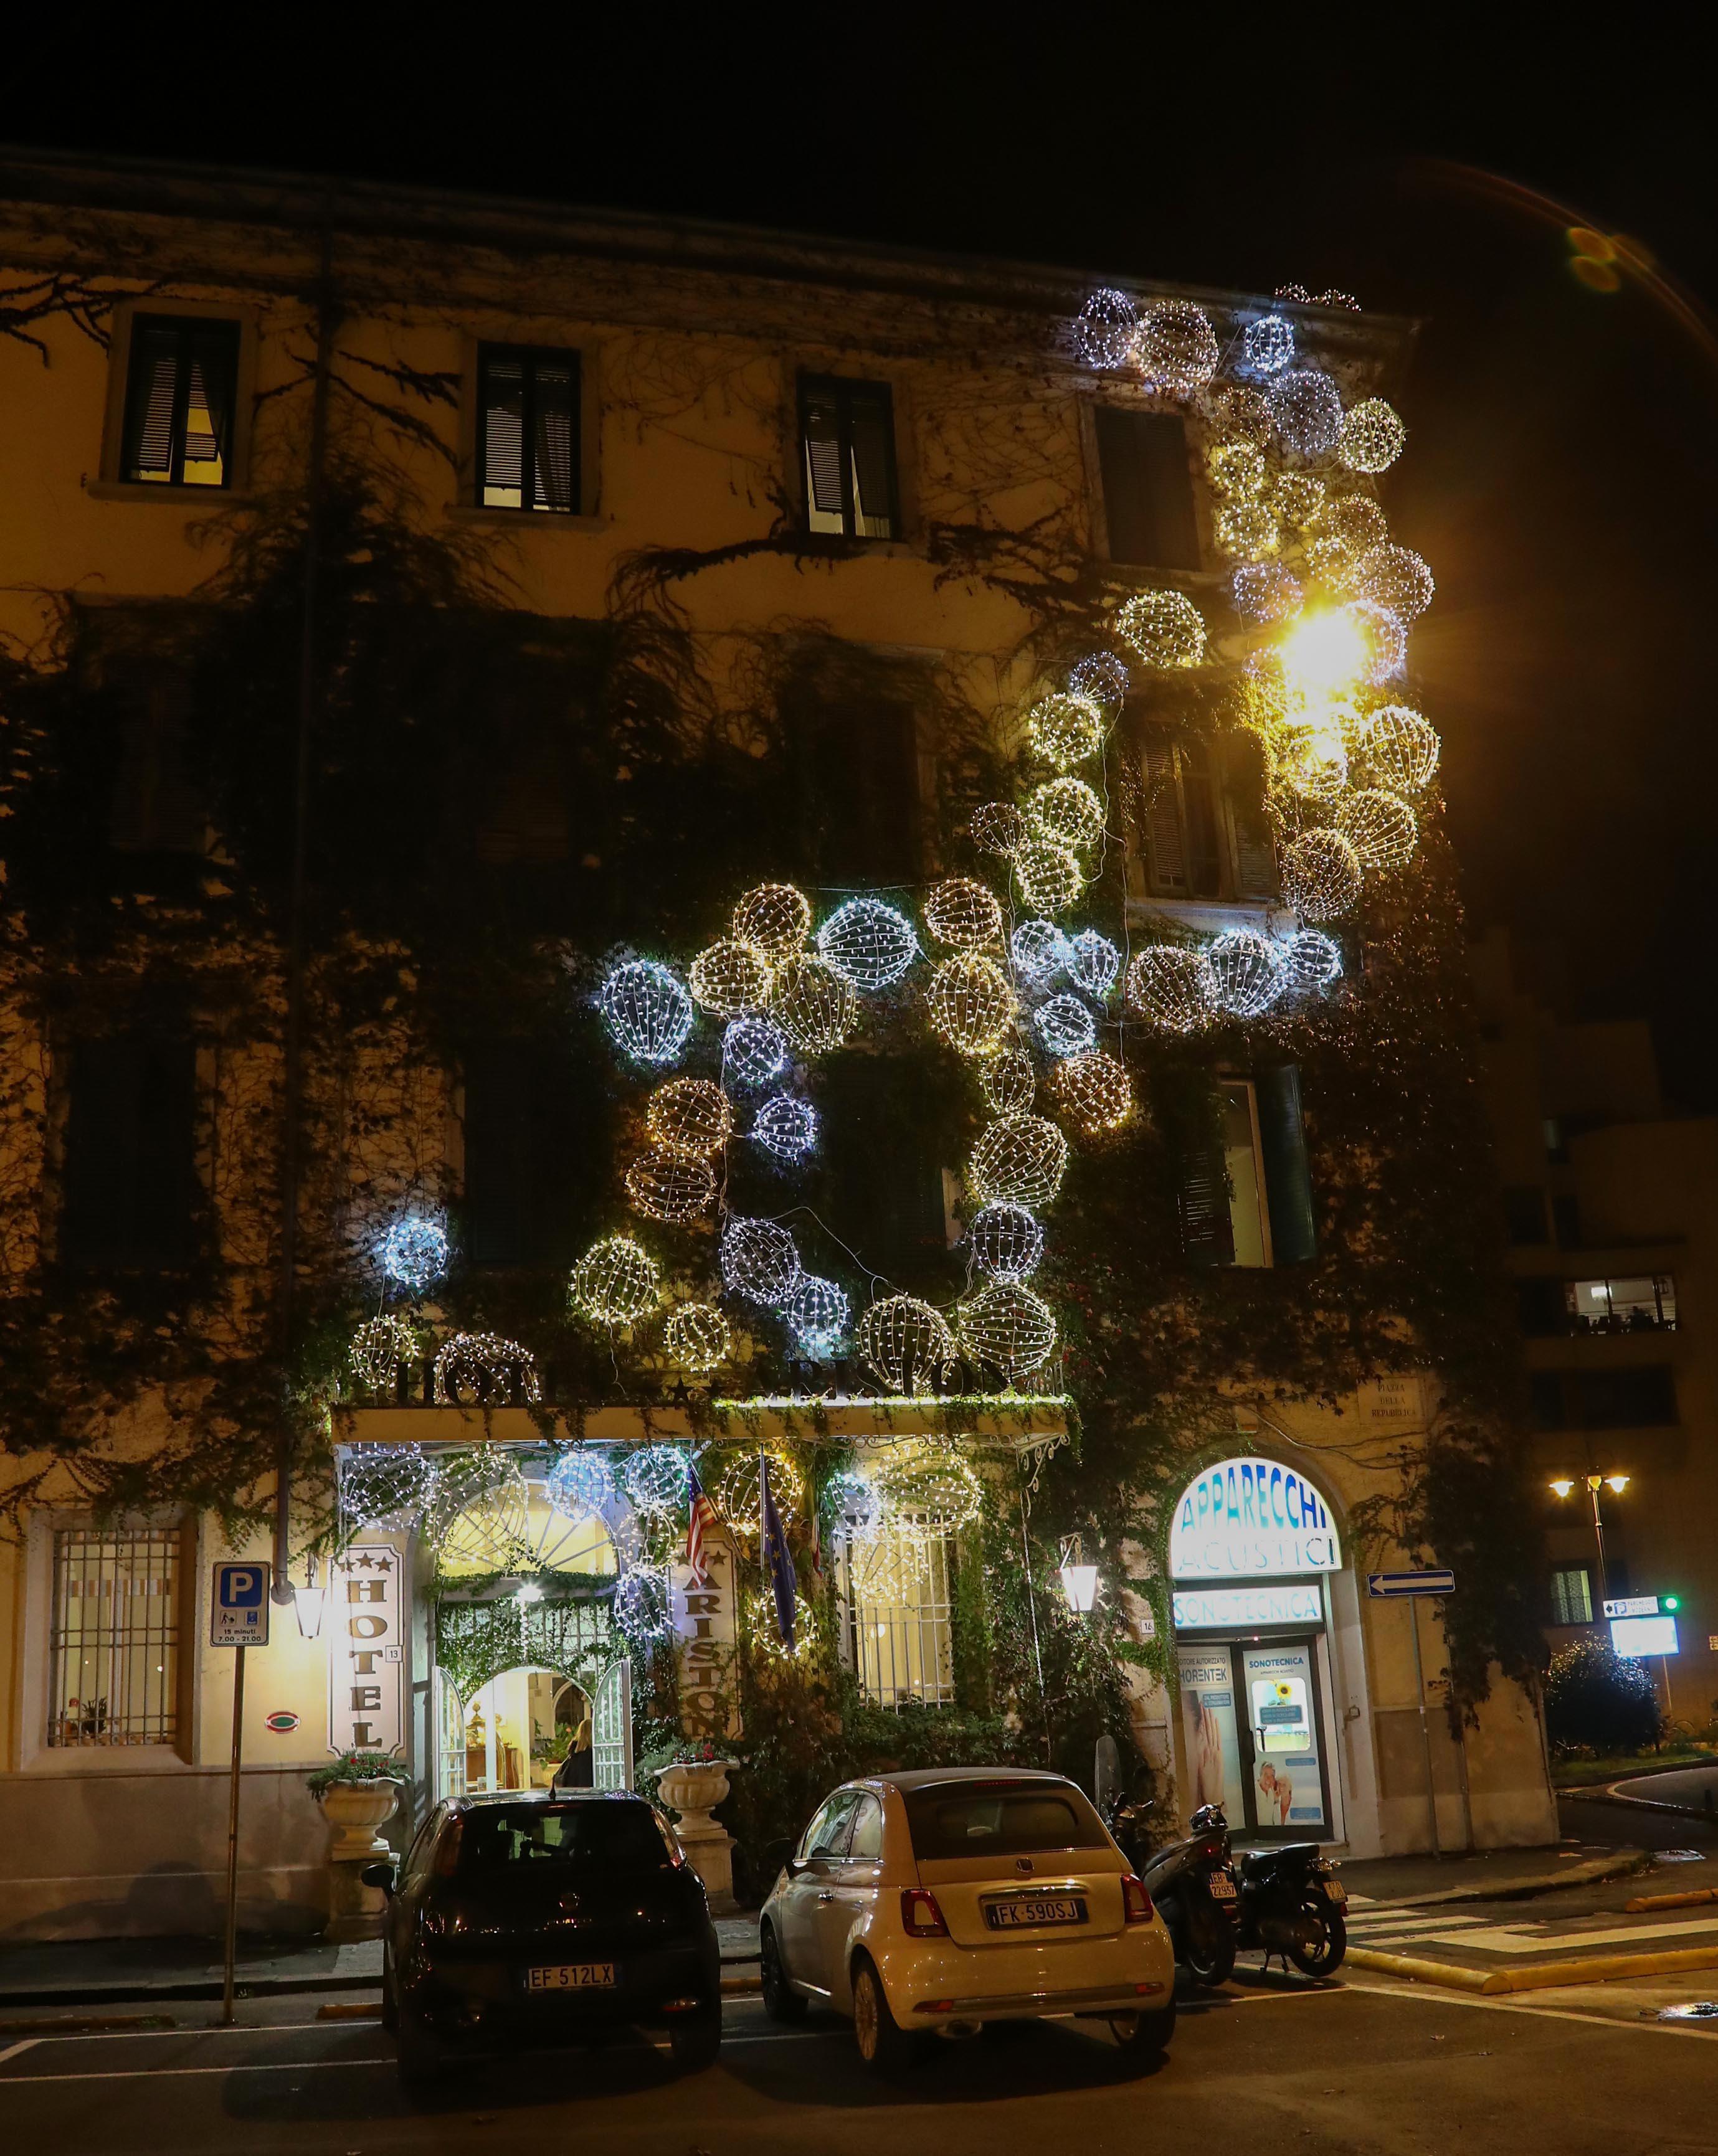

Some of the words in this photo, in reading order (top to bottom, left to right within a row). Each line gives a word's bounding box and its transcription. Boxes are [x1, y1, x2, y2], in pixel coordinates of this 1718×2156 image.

[1181, 1464, 1327, 1533] APPARECCHI
[1179, 1537, 1334, 1571] ACUSTICI
[229, 1572, 254, 1602] P
[1173, 1592, 1318, 1625] SONOTECNICA
[343, 1579, 389, 1748] HOTEL
[390, 1650, 398, 1658] 13
[683, 1572, 726, 1738] ARISTON
[1249, 1657, 1304, 1668] SONOTECNICA
[1212, 1885, 1234, 1896] 22937
[999, 1905, 1020, 1923] FK
[1026, 1901, 1076, 1921] 590SJ
[531, 1969, 552, 1987] EF
[560, 1965, 612, 1985] 512LX
